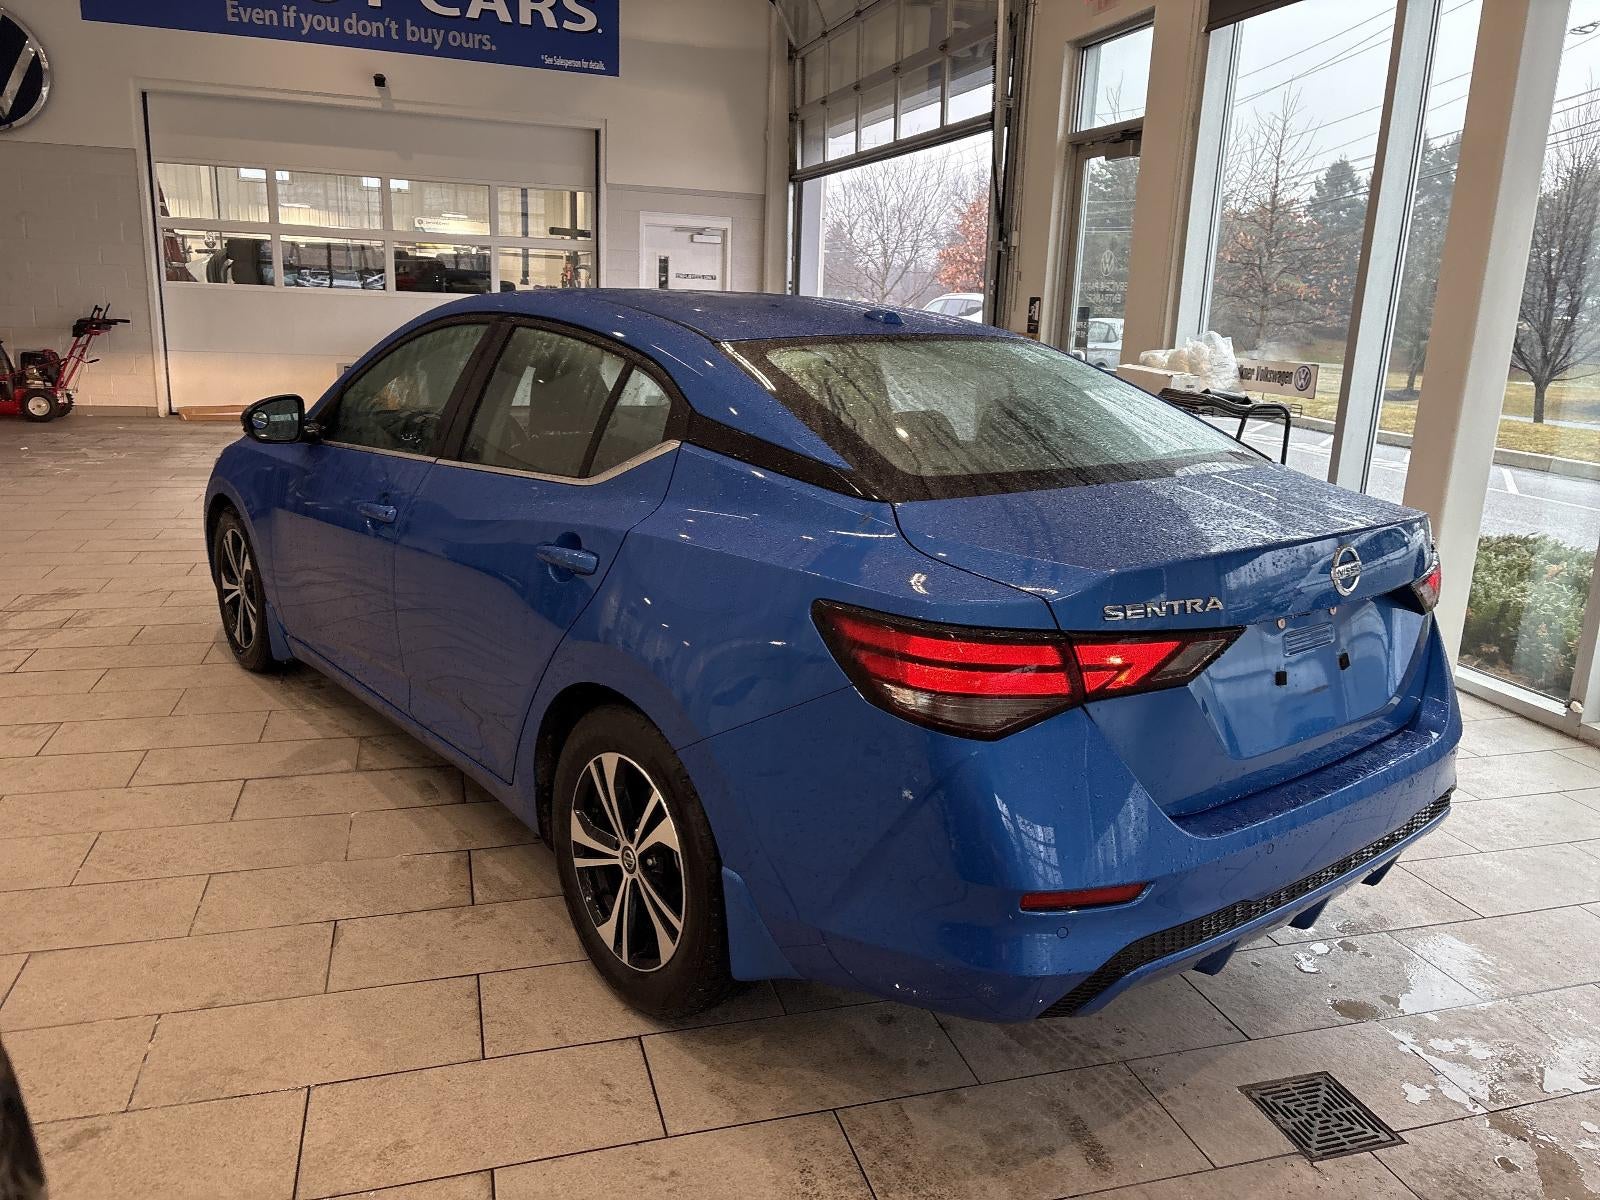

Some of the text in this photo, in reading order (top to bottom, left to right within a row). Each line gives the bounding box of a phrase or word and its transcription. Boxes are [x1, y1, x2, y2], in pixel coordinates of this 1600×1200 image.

[226, 0, 497, 51] Even if you don't buy ours.
[1103, 596, 1225, 622] SENTRA
